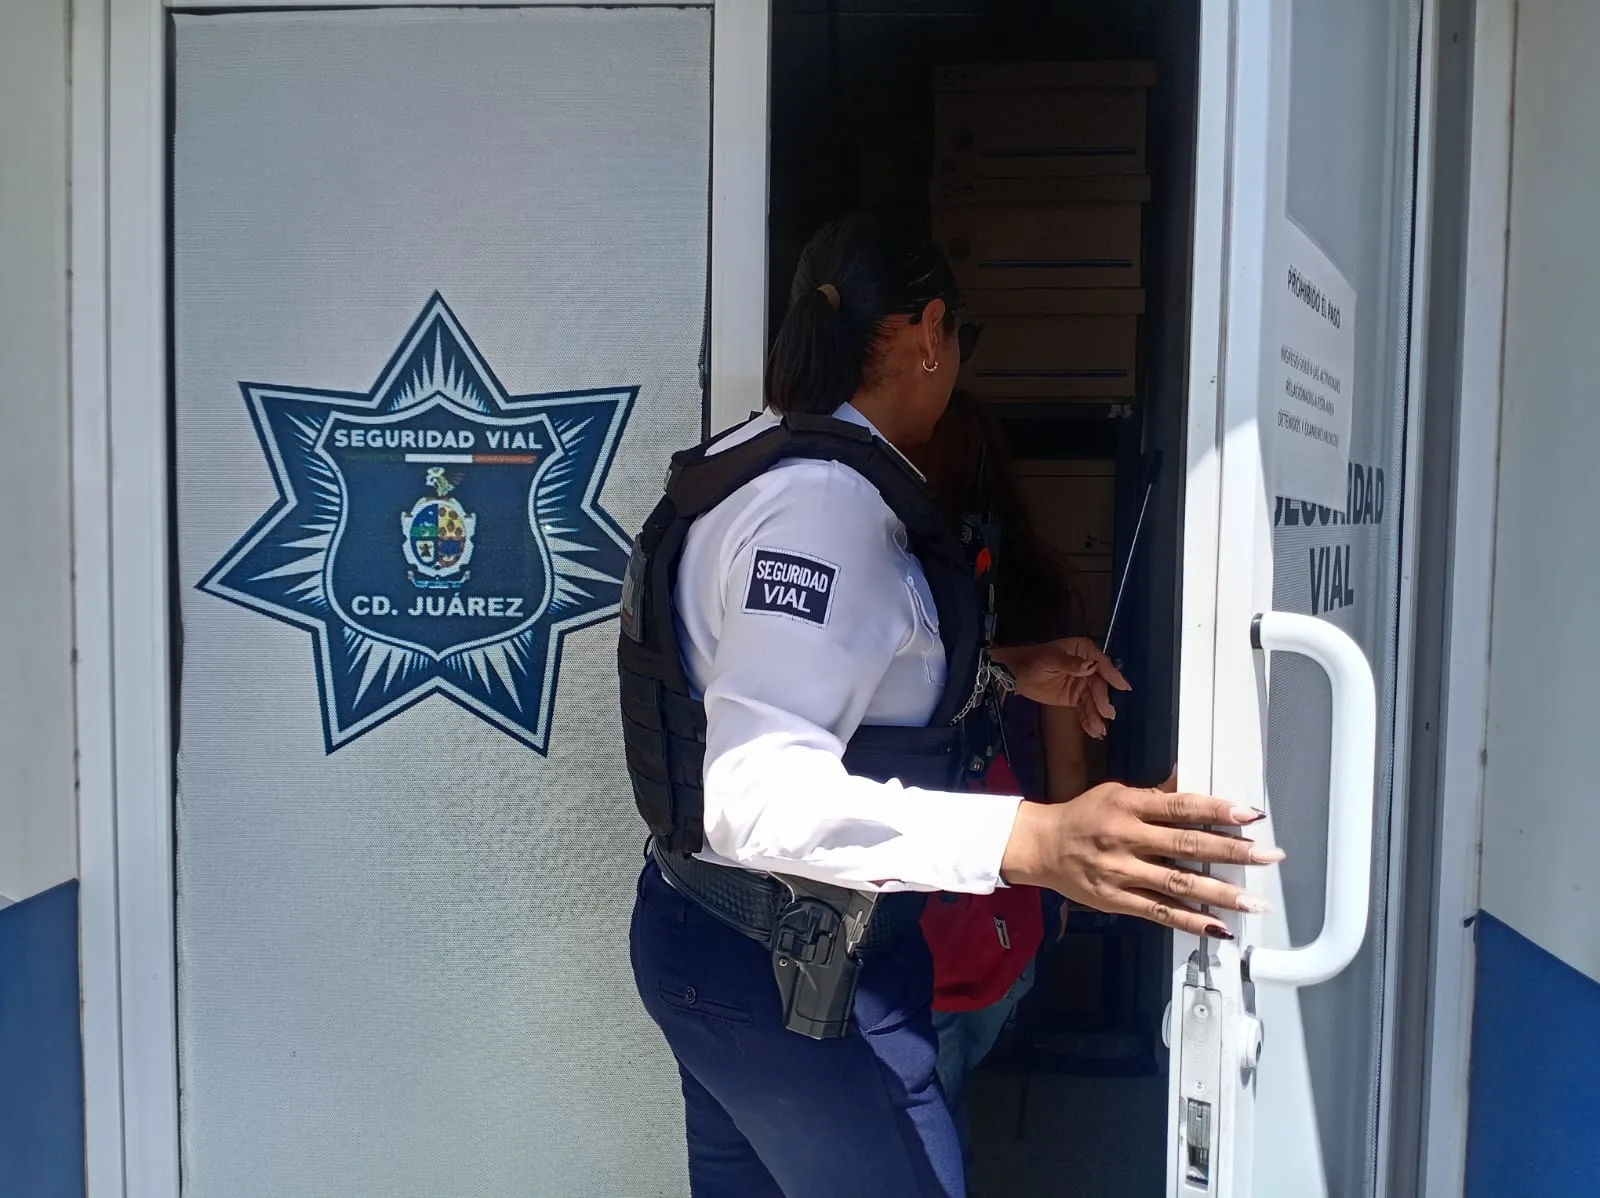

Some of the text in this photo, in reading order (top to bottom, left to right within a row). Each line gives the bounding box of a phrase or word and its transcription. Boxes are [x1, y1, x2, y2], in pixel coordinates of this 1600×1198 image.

[1288, 269, 1320, 312] PROHIBIDO
[1328, 303, 1340, 328] PASO
[334, 430, 543, 449] SEGURIDAD VIAL
[756, 560, 829, 593] SEGURIDAD
[1309, 544, 1354, 616] VIAL
[351, 592, 523, 617] CD. JUÁREZ
[764, 583, 811, 613] VIAL
